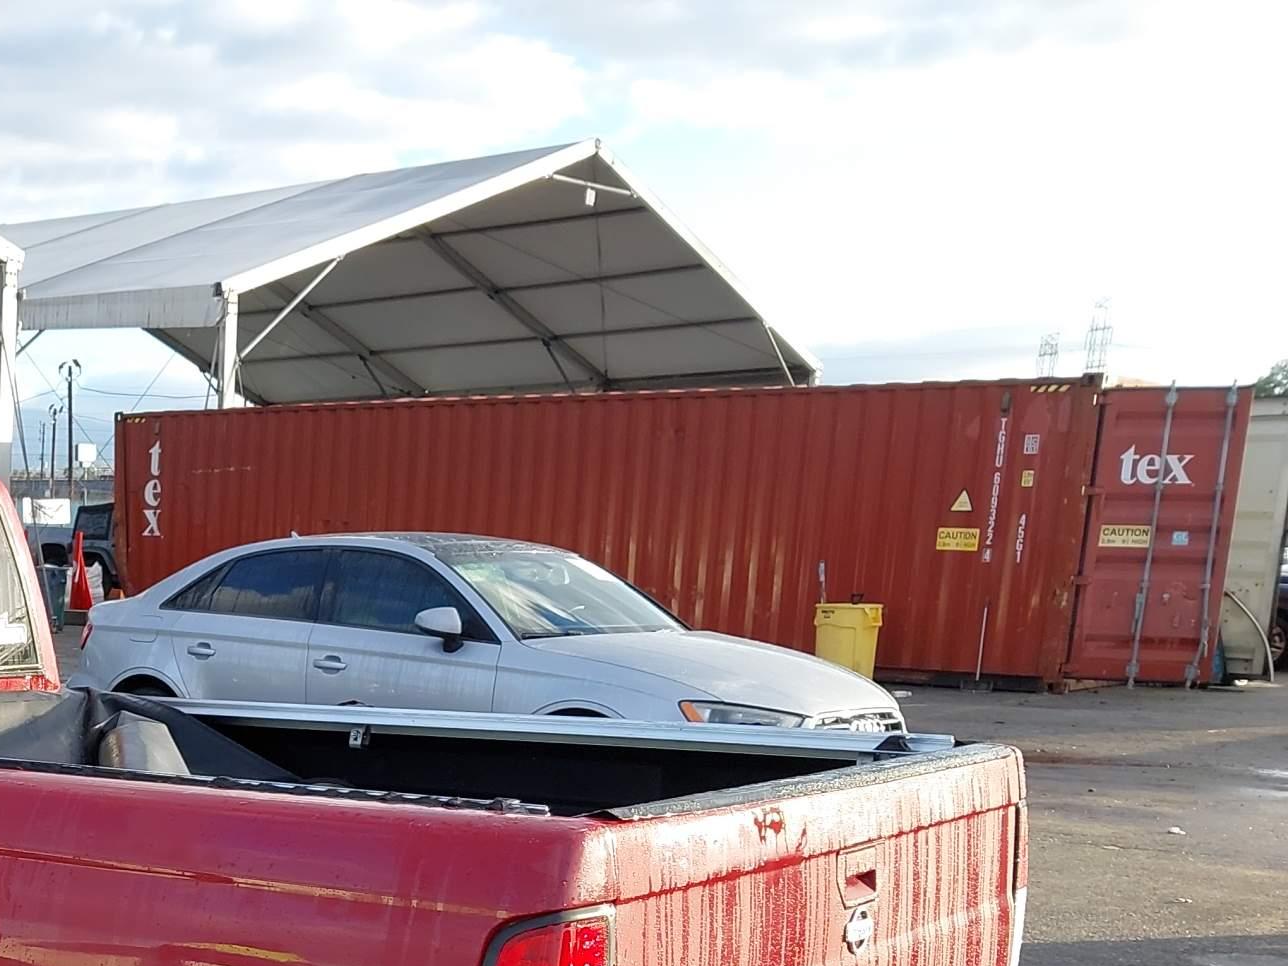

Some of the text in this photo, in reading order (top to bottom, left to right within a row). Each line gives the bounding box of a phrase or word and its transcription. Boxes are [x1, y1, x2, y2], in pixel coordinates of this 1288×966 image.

[1120, 444, 1196, 485] tex
[141, 440, 162, 536] tex
[938, 530, 977, 540] CAUTION
[1101, 527, 1150, 537] CAUTION
